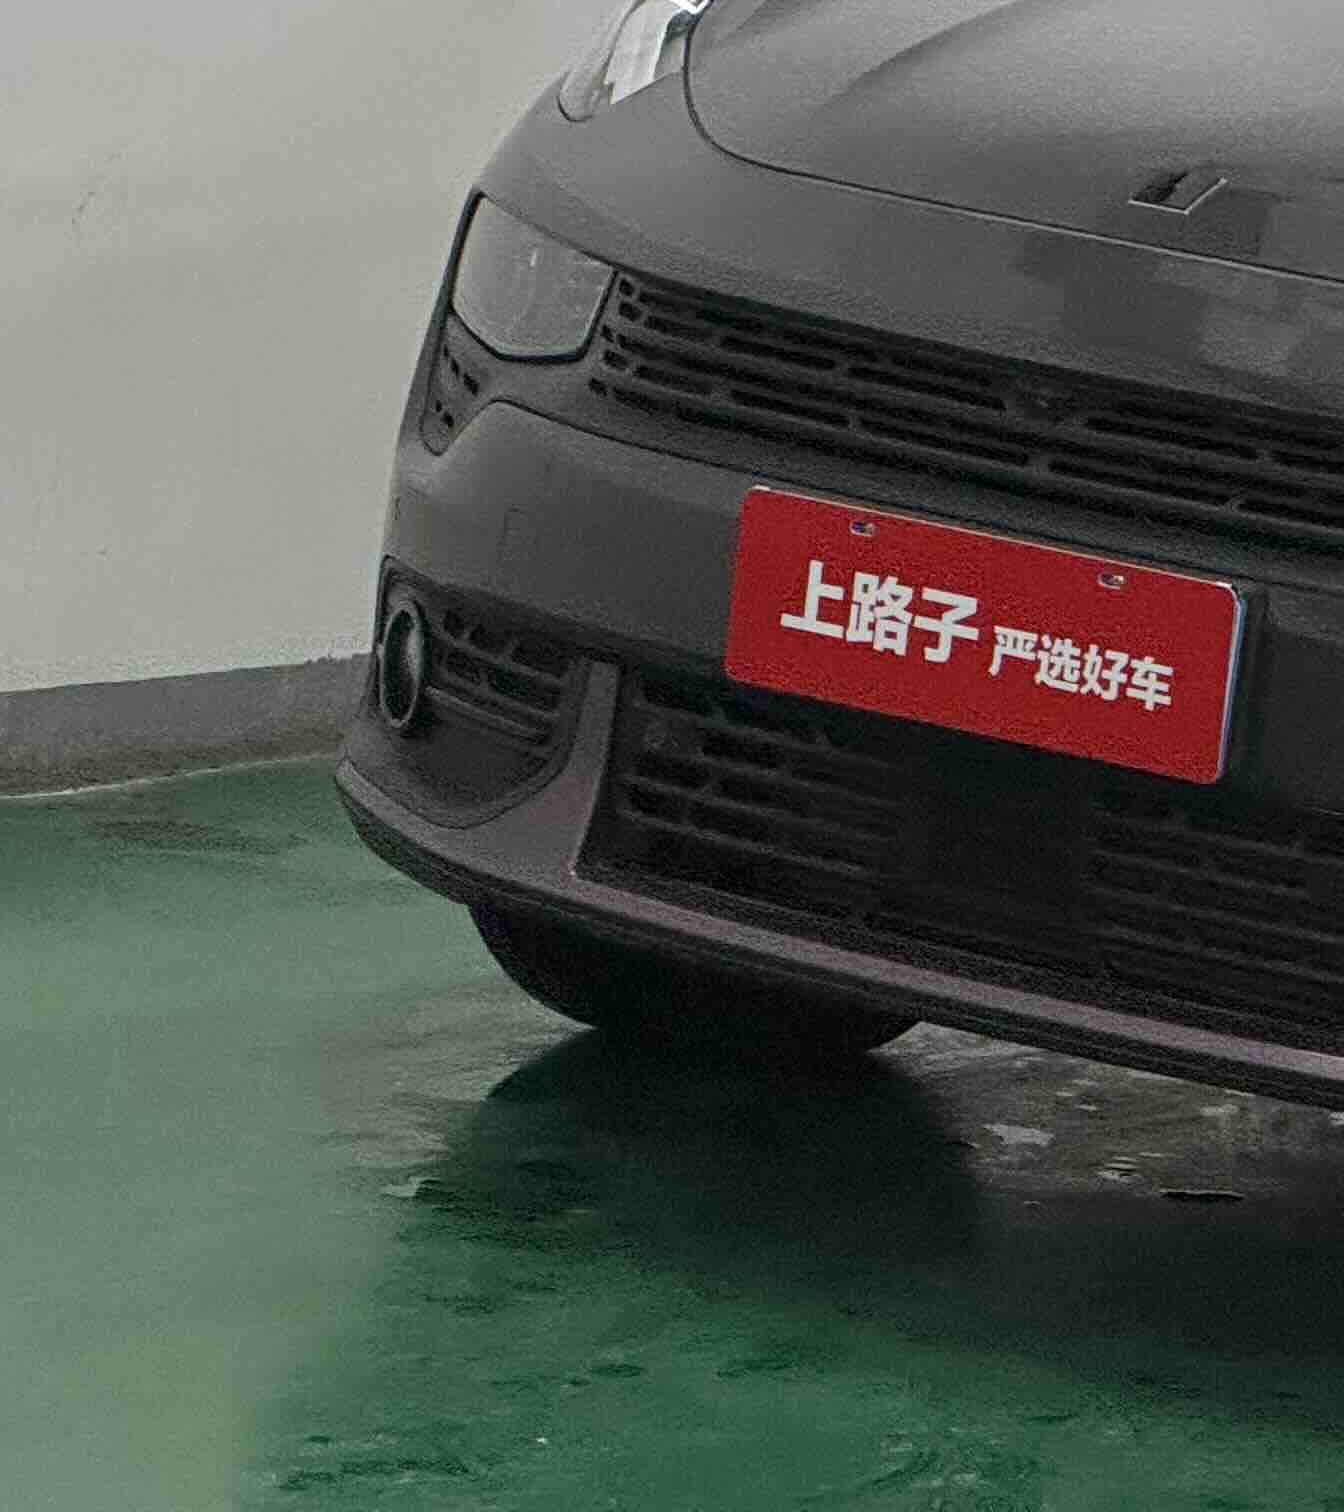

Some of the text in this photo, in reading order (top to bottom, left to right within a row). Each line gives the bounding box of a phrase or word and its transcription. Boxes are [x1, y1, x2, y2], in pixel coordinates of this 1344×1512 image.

[780, 560, 1173, 712] 上路子 严选好车
